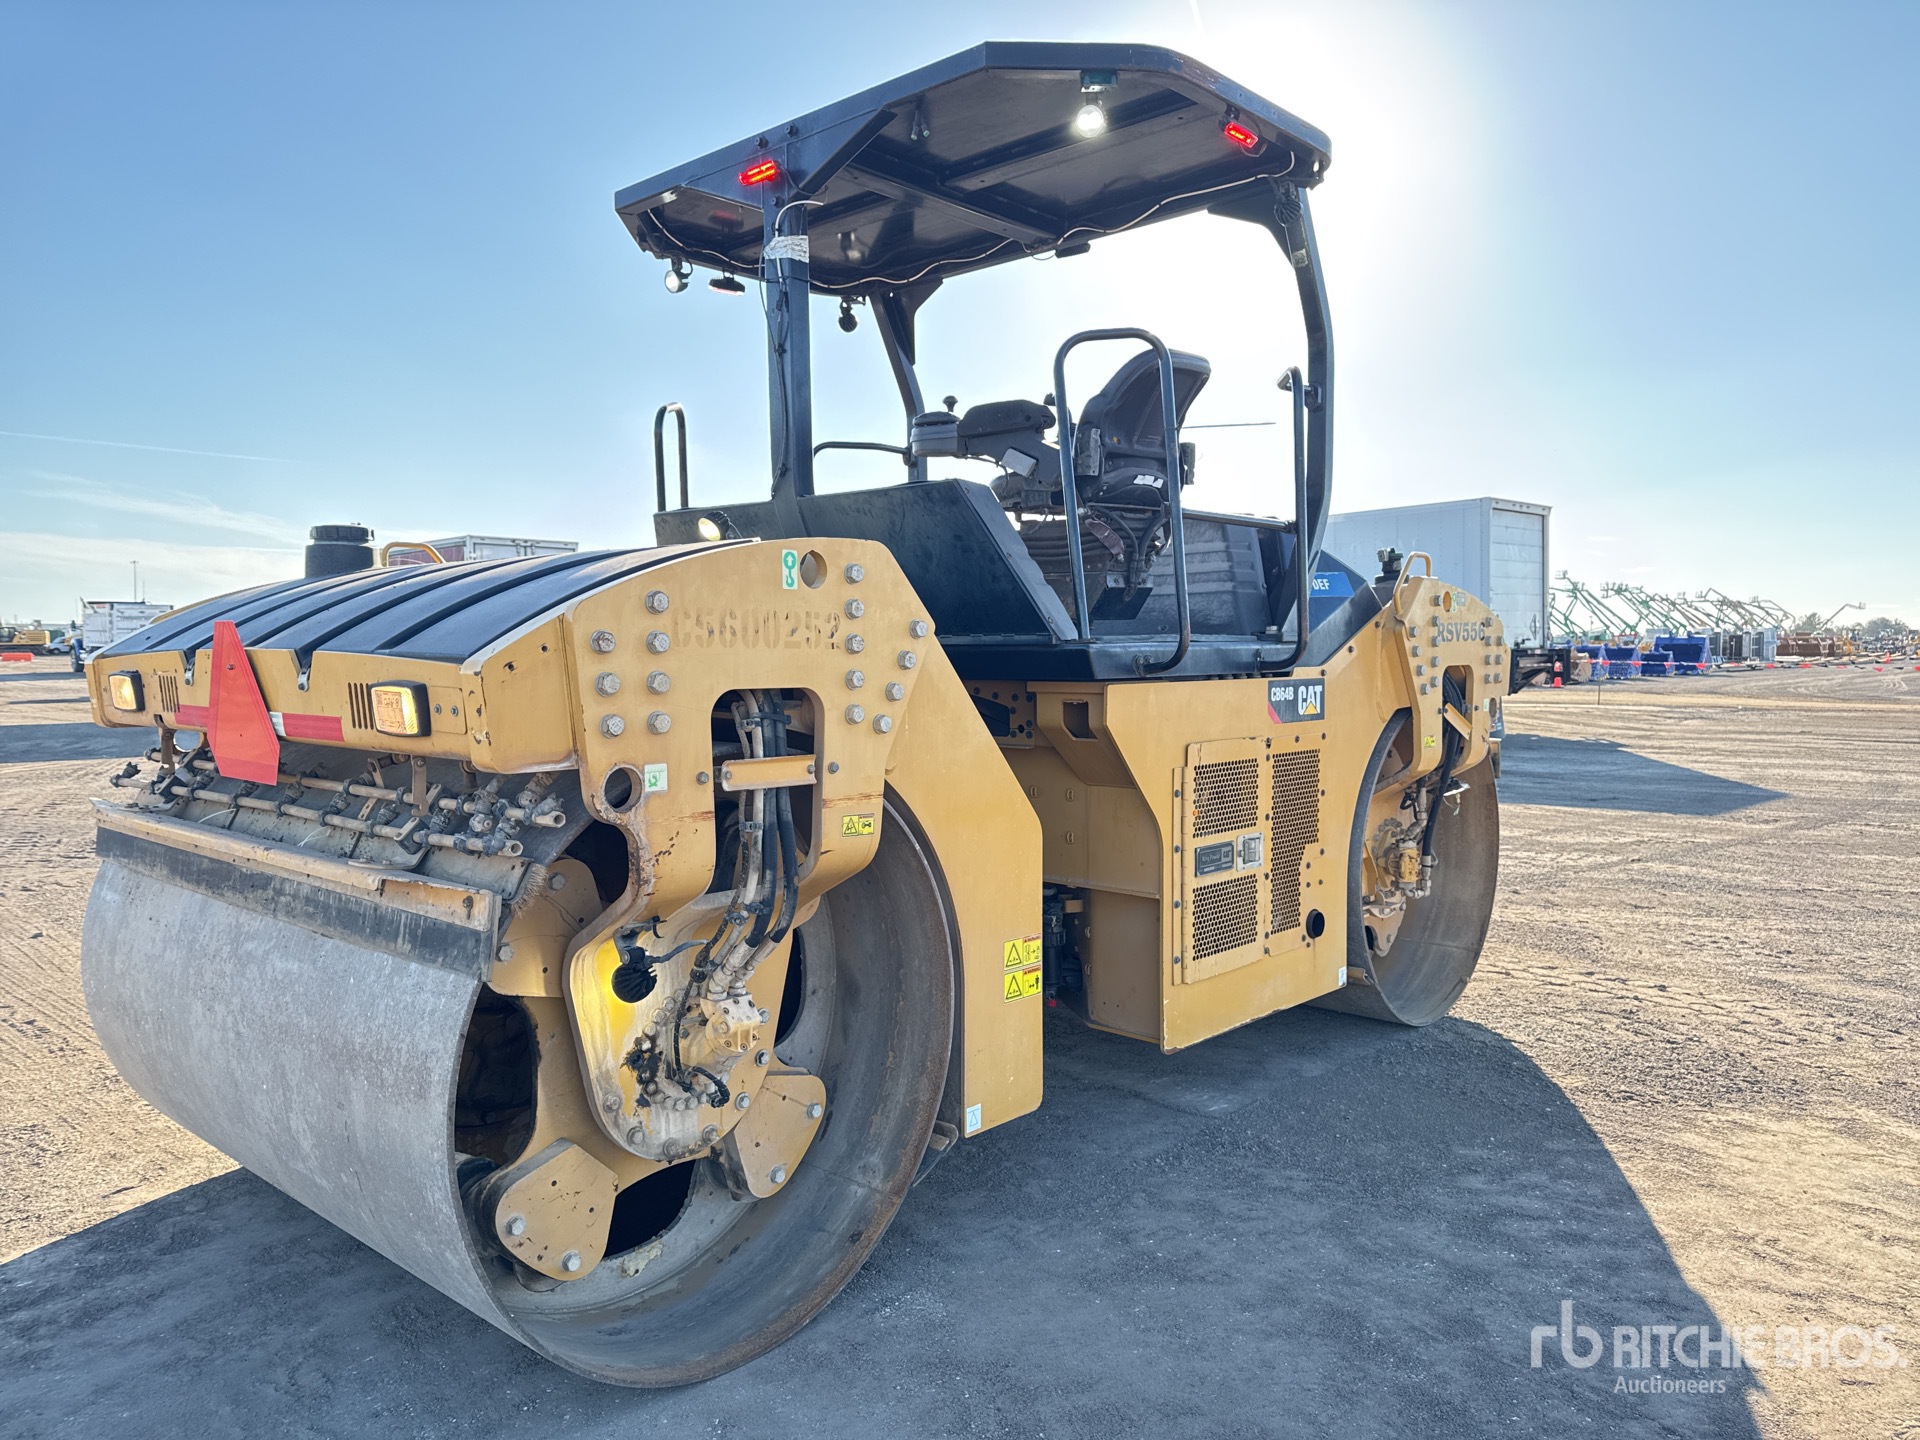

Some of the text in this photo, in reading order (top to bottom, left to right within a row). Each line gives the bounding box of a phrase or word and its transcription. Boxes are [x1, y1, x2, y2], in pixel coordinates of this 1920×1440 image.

[1312, 578, 1330, 590] DEF
[1437, 621, 1486, 643] RSV556
[1271, 685, 1323, 715] CB64B CAT
